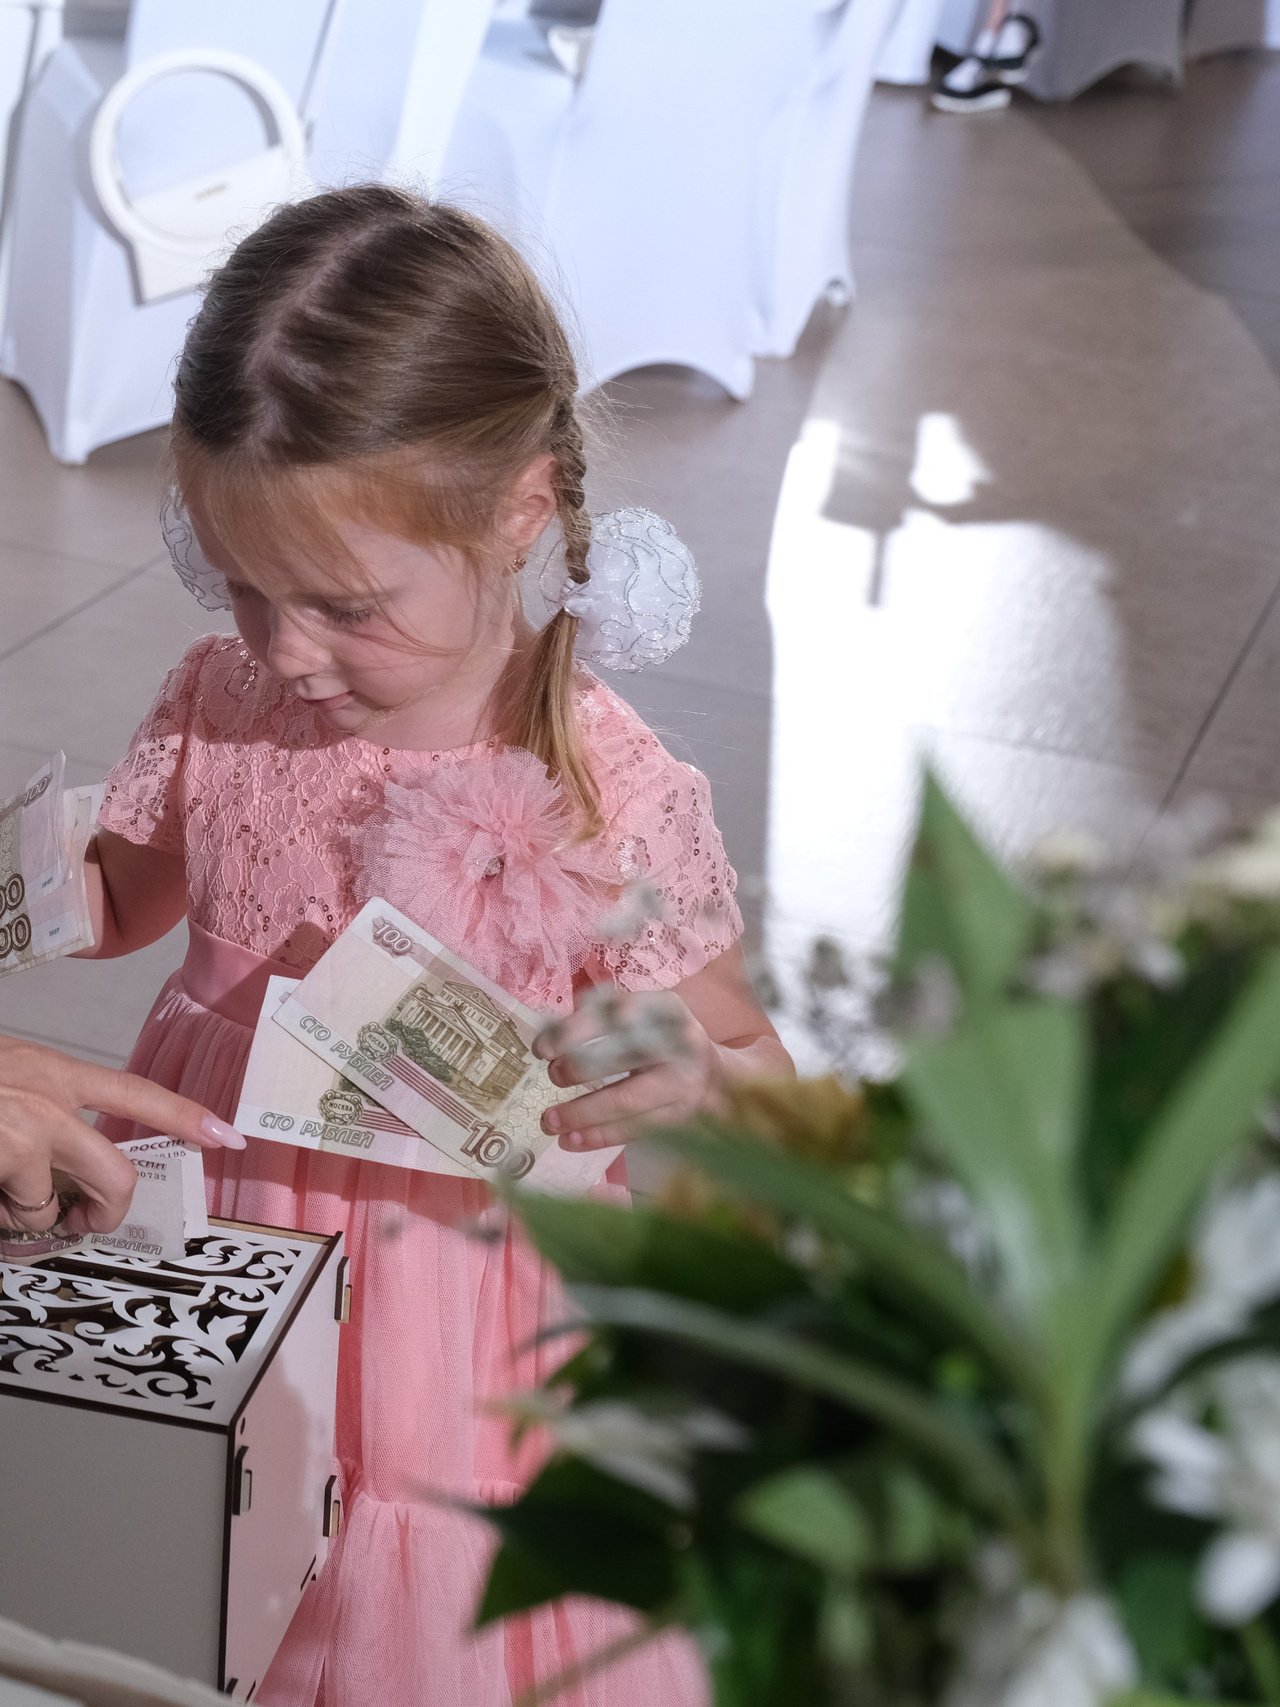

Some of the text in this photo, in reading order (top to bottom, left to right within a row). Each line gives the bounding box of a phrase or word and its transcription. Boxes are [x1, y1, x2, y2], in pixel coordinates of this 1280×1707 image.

[23, 775, 50, 807] 100
[373, 923, 413, 956] 100
[300, 1015, 395, 1092] СТО РУБЛЕЙ
[329, 1102, 353, 1113] МОСКВА
[259, 1111, 375, 1149] СТО РУБЛЕЙ
[91, 1234, 163, 1256] РУБЛЕЙ
[128, 1226, 145, 1240] 100
